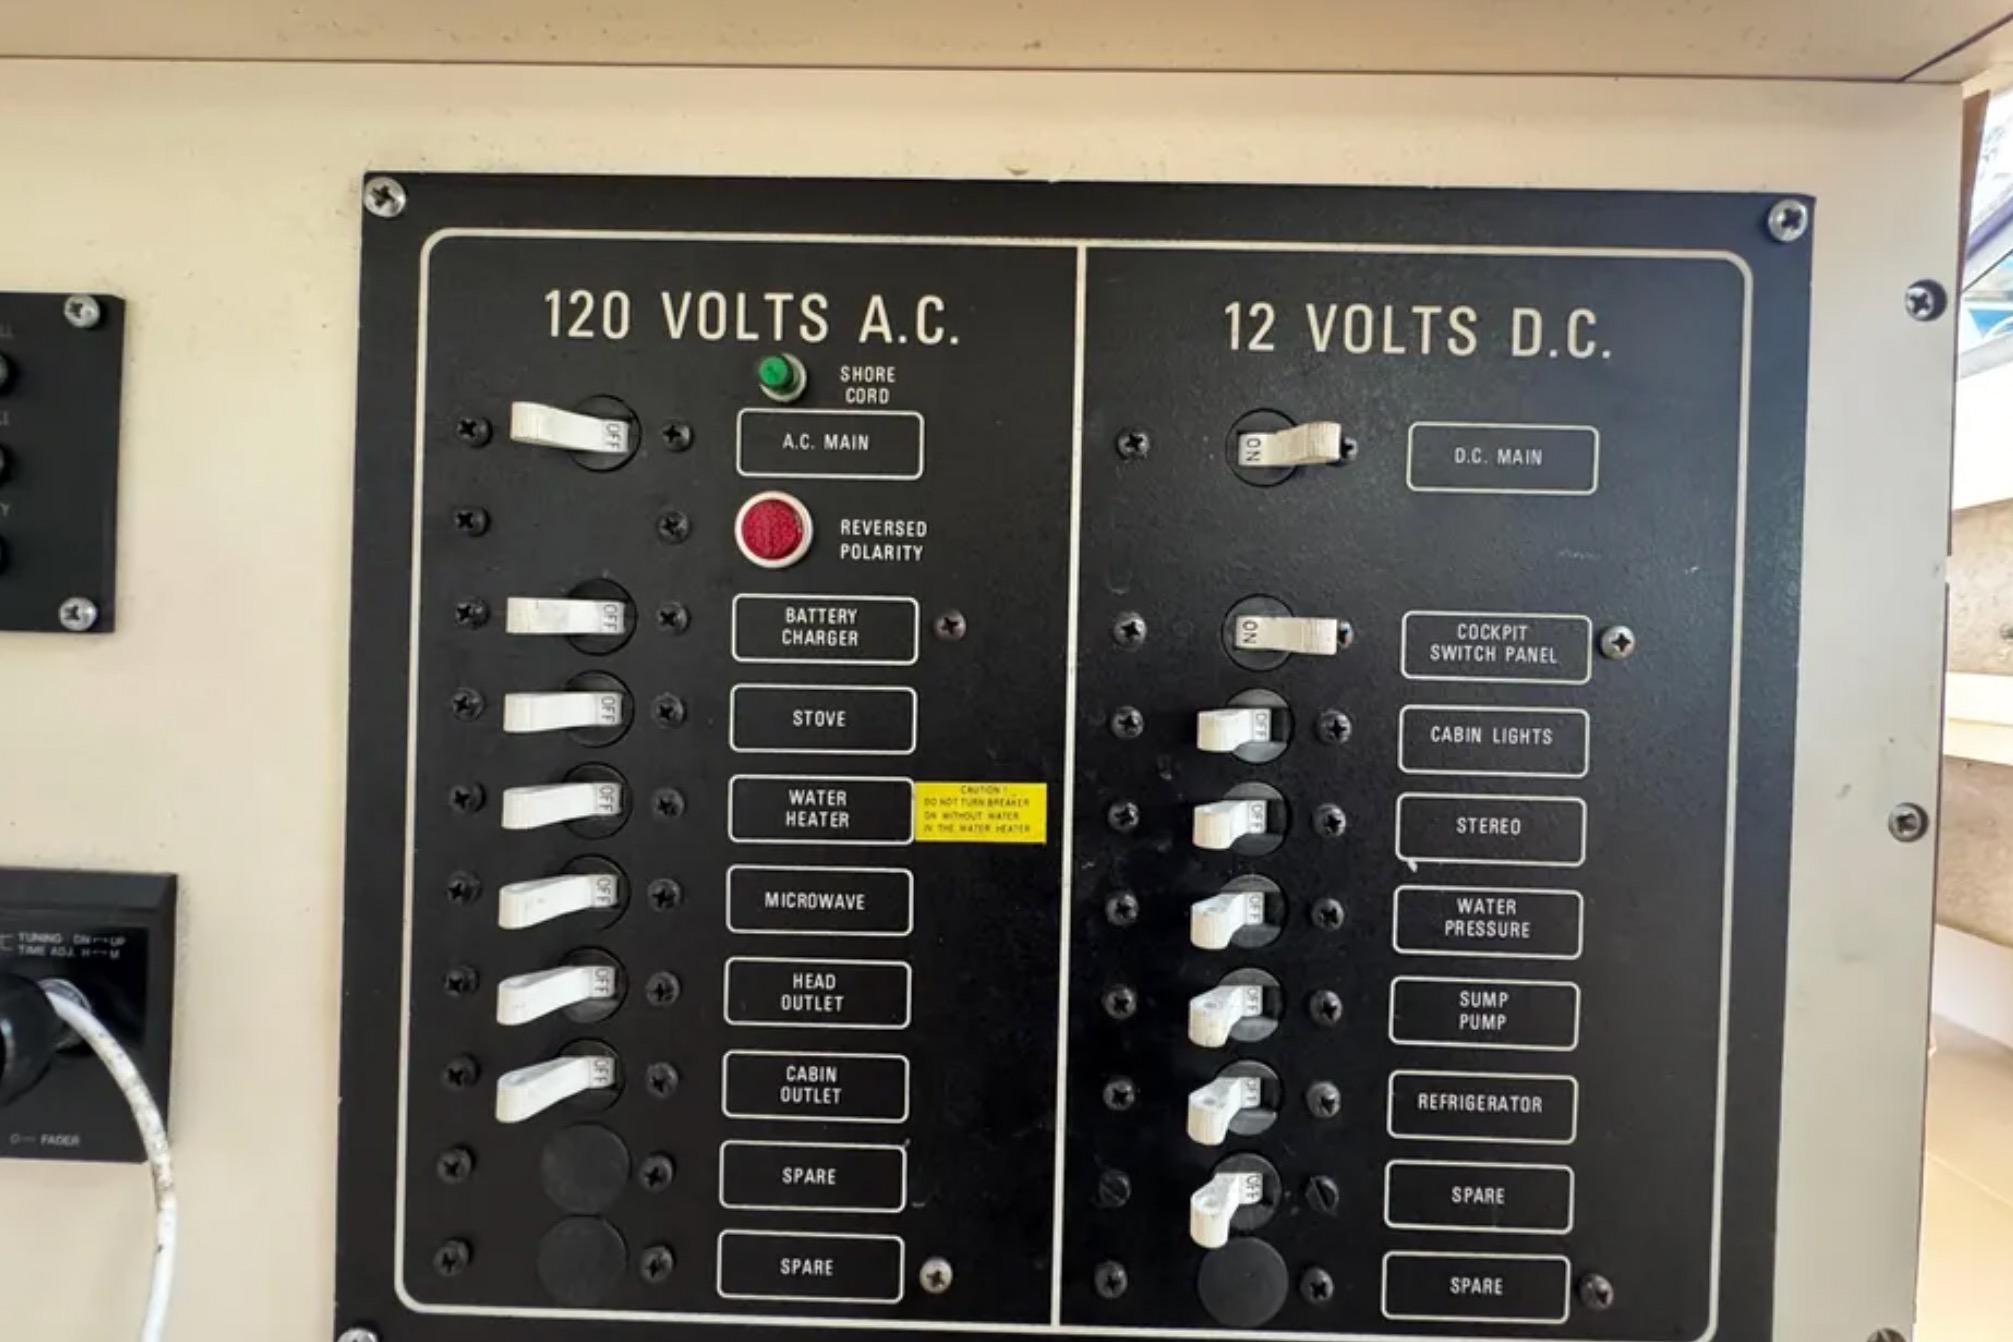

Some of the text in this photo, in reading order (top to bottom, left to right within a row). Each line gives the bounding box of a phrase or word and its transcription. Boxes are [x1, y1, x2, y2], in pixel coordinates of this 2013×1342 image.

[544, 289, 961, 345] 120 VOLTS A.C.
[1224, 301, 1613, 359] 12 VOLTS D.C.
[840, 365, 895, 383] SHORE
[845, 387, 890, 405] CORD
[606, 424, 620, 449] OFF
[782, 433, 869, 451] A.C. MAIN
[1247, 438, 1261, 462] ON
[1454, 447, 1543, 466] D.C. MAIN
[840, 518, 927, 538] REVERSED
[840, 542, 923, 561] POLARITY
[603, 605, 617, 631] OFF
[785, 606, 858, 625] BATTERY
[781, 628, 859, 647] CHARGER
[1242, 621, 1256, 644] ON
[1457, 623, 1529, 641] COCKPIT
[1430, 643, 1557, 664] SWITCH PANEL
[602, 697, 615, 722] OFF
[792, 709, 846, 728] STOVE
[1255, 713, 1267, 741] OFF
[1430, 725, 1553, 745] CABIN LIGHTS
[600, 786, 614, 812] OFF
[788, 789, 847, 806] WATER
[960, 785, 1000, 794] CAUTION
[940, 798, 957, 806] NOT
[960, 798, 984, 806] TURN
[987, 799, 1029, 807] BREAKER
[785, 810, 850, 828] HEATER
[924, 811, 1019, 820] ON WITHOUT WATER
[1251, 805, 1263, 832] OFF
[924, 824, 932, 832] IN
[938, 824, 954, 832] THE
[996, 825, 1030, 833] HEATER
[1456, 817, 1521, 836] STEREO
[597, 878, 611, 904] OFF
[764, 891, 865, 911] MICROWAVE
[1250, 896, 1261, 923] OFF
[1456, 897, 1517, 915] WATER
[1444, 919, 1531, 939] PRESSURE
[18, 932, 63, 943] TUNING
[110, 936, 126, 947] UP
[18, 944, 47, 956] TIME
[595, 969, 610, 994] OFF
[792, 973, 836, 990] HEAD
[781, 993, 844, 1012] OUTLET
[1459, 990, 1509, 1008] SUMP
[1459, 1013, 1507, 1030] PUMP
[595, 1060, 609, 1083] OFF
[786, 1065, 837, 1083] CABIN
[780, 1085, 842, 1104] OUTLET
[1418, 1093, 1543, 1113] REFRIGERATOR
[40, 1134, 80, 1146] FADER
[782, 1166, 836, 1185] SPARE
[1451, 1186, 1505, 1205] SPARE
[780, 1257, 833, 1276] SPARE
[1450, 1276, 1503, 1295] SPARE
